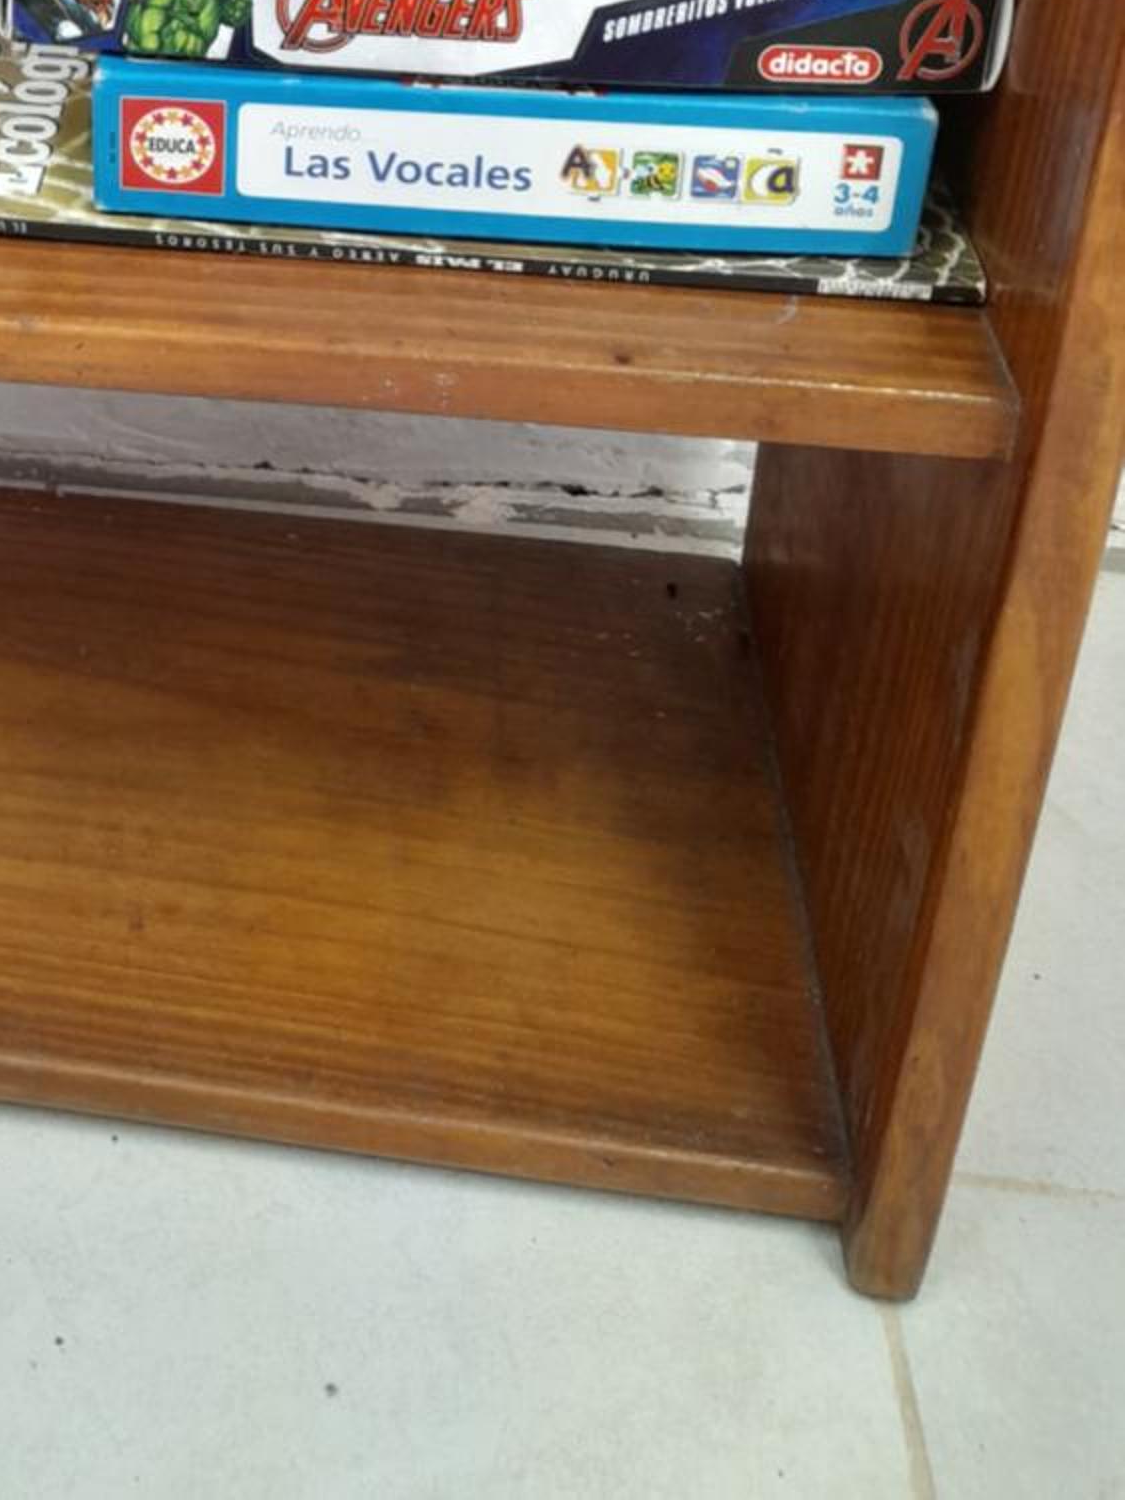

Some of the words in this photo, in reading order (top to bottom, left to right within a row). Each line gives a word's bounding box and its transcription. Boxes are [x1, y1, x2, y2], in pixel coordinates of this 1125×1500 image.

[768, 50, 874, 79] didacta
[147, 136, 197, 155] EDUCA
[284, 146, 351, 180] Las
[368, 150, 533, 192] Vocales
[833, 183, 881, 205] 3-4
[833, 203, 875, 218] años
[13, 221, 29, 235] EL
[153, 233, 246, 251] TESOROS
[259, 241, 296, 256] SUS
[309, 246, 319, 258] Y
[548, 264, 651, 283] URUGUAY
